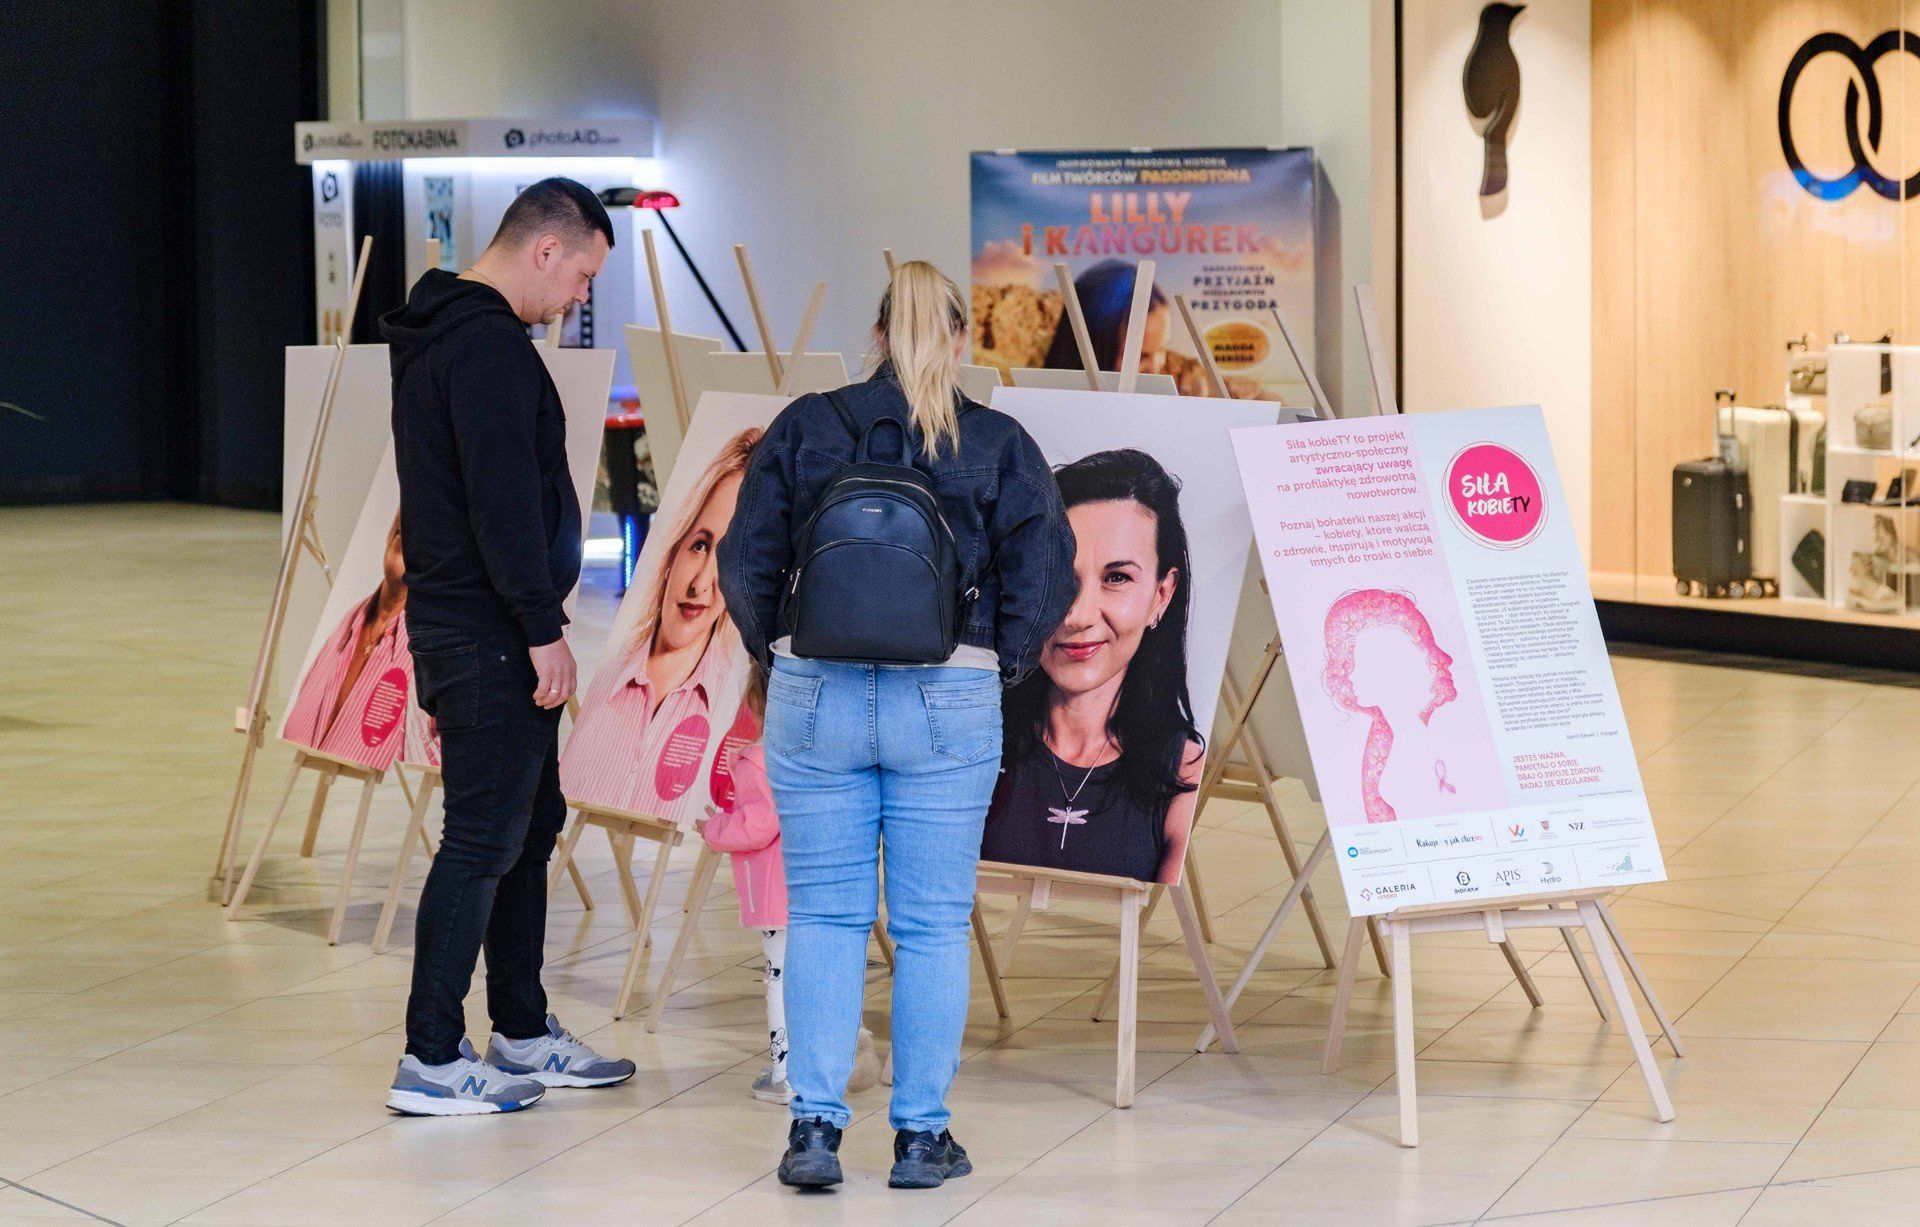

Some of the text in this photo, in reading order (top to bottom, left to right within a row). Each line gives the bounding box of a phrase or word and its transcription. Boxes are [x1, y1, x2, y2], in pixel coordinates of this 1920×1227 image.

[373, 129, 458, 151] FOTOKABINA
[1031, 168, 1251, 185] FILM TWÓRCÓW PADDINGTONA
[1090, 191, 1192, 223] LILLY
[1045, 223, 1260, 255] KANGUREK
[1191, 300, 1278, 310] PRZYGODA
[1286, 431, 1405, 449] Siła kobieTY to projekt
[1289, 445, 1408, 463] artystyczno-społeczny
[1315, 458, 1412, 475] zwracający uwagę
[1277, 471, 1415, 491] na profilaktykę zdrowotną
[1346, 485, 1418, 499] nowotworów.
[1467, 495, 1531, 517] KOBIETY
[1280, 508, 1425, 532] Poznaj bohaterki naszej akcji
[1324, 528, 1363, 540] kobiety,
[1365, 525, 1391, 535] które
[1394, 522, 1428, 533] walczą
[1283, 543, 1326, 557] zdrowie,
[1329, 540, 1373, 553] inspirują
[1382, 535, 1432, 548] motywują
[1310, 554, 1344, 567] innych
[1347, 553, 1360, 563] do
[1363, 550, 1391, 561] troski
[1403, 546, 1434, 557] siebie.
[1517, 772, 1535, 780] DBAJ
[1544, 769, 1568, 777] SWOJE
[1520, 781, 1542, 789] BADAJ
[1544, 779, 1554, 787] SIĘ
[1494, 868, 1520, 882] APIS
[1540, 876, 1561, 885] Hydro
[1375, 883, 1415, 894] GALERIA
[543, 1052, 572, 1073] N
[459, 1075, 488, 1097] N
